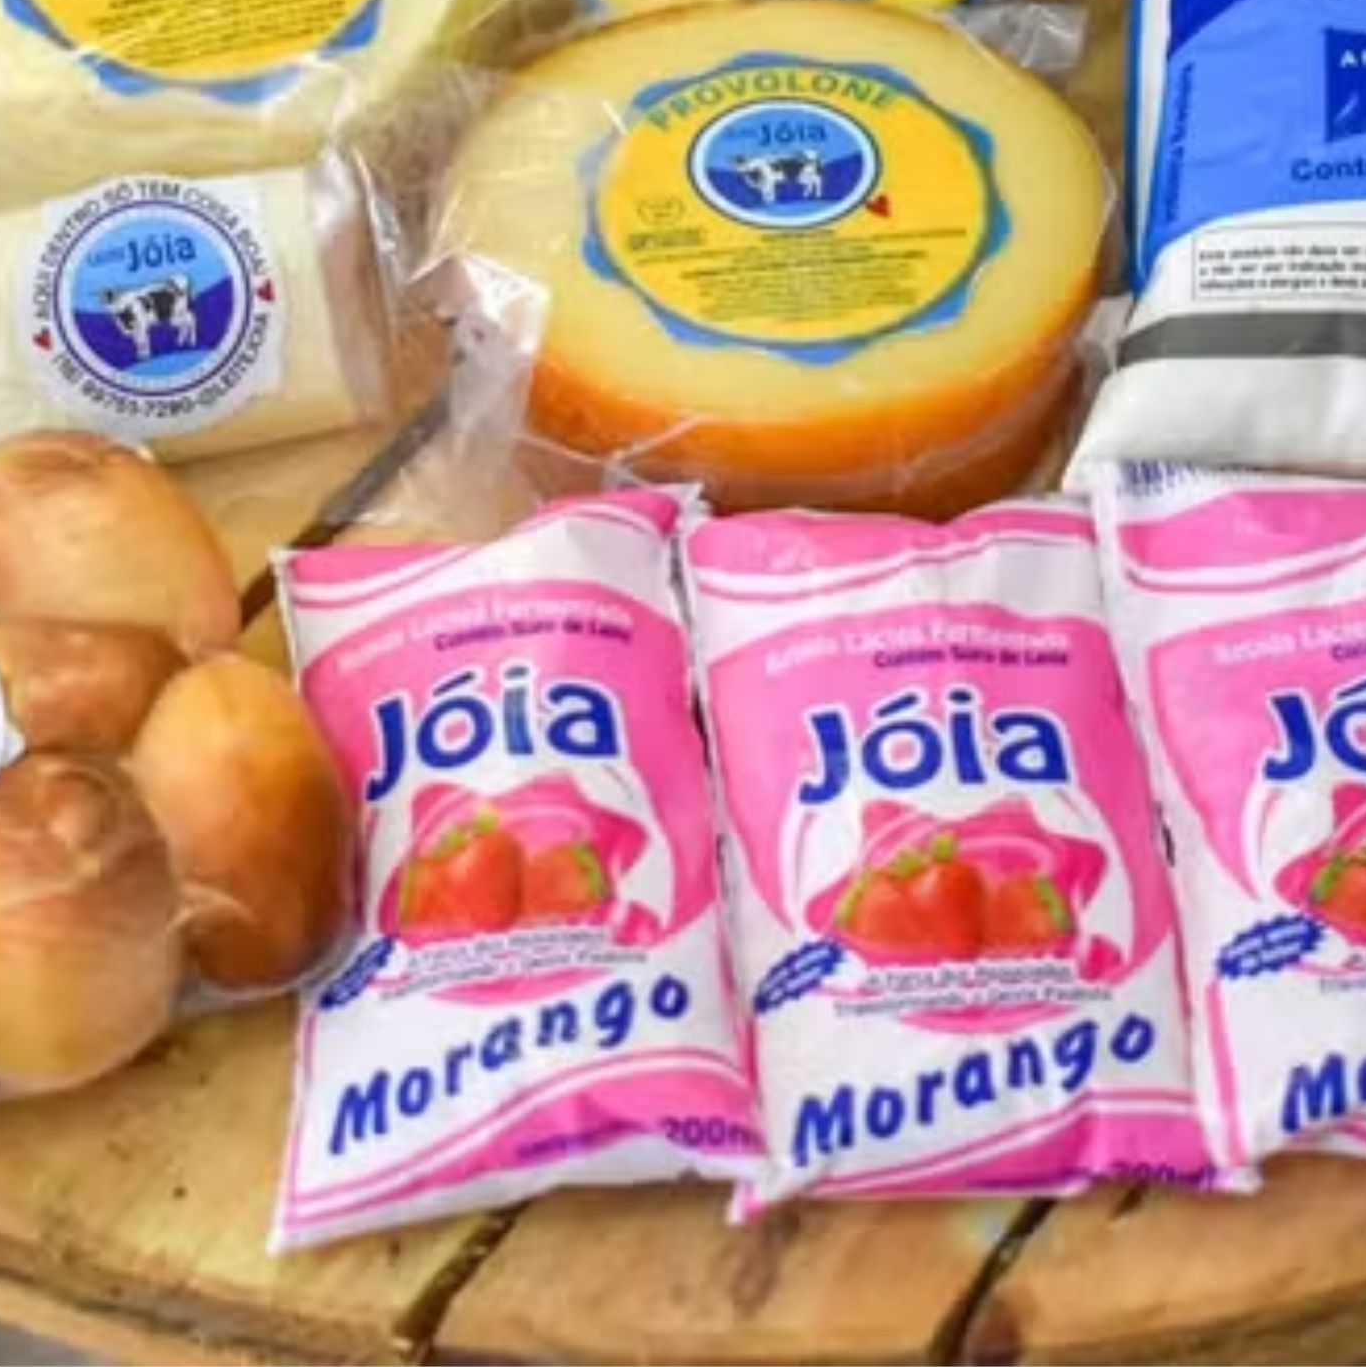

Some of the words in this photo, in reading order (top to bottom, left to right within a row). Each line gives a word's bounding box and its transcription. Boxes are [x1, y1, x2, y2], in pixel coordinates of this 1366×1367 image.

[1339, 48, 1359, 68] A
[642, 69, 897, 130] PROVOLONE
[754, 122, 827, 148] Jóia
[137, 180, 181, 199] TEM
[126, 234, 198, 273] Jóia
[366, 666, 621, 803] Jóia
[797, 689, 1070, 805] Jóia
[328, 973, 691, 1157] Morango
[790, 1012, 1157, 1169] Morango
[662, 1116, 766, 1148] 200m
